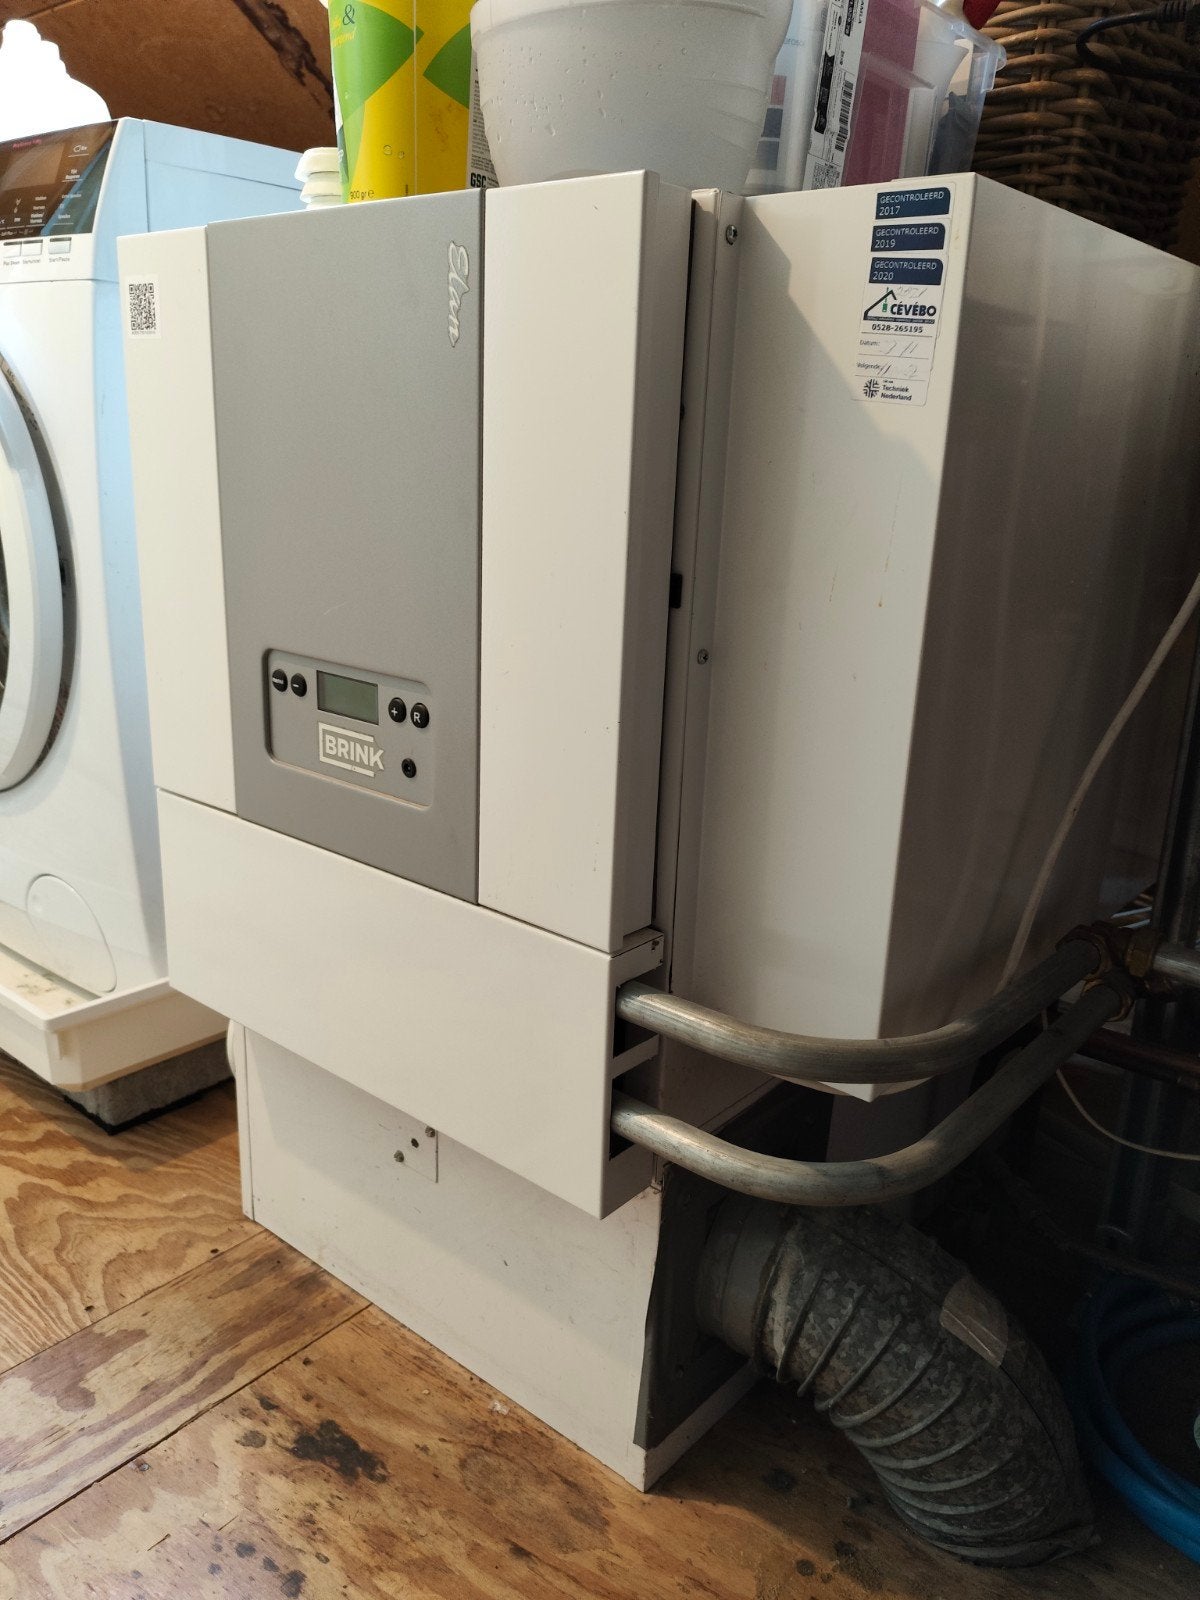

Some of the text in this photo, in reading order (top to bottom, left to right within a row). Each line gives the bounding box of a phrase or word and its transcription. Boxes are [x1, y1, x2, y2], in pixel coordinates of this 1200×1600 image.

[879, 191, 945, 204] GECONTROLEERD
[879, 206, 901, 216] 2017
[875, 226, 940, 237] GECONTROLEERD
[874, 239, 896, 248] 2019
[874, 260, 937, 270] GECONTROLEERD
[872, 271, 894, 281] 2020
[890, 301, 937, 317] CÉVÉBO
[871, 323, 924, 334] 0528-265195
[882, 384, 910, 393] Techniek
[880, 392, 913, 402] Nederland
[413, 712, 421, 723] R
[325, 733, 385, 770] BRINK
